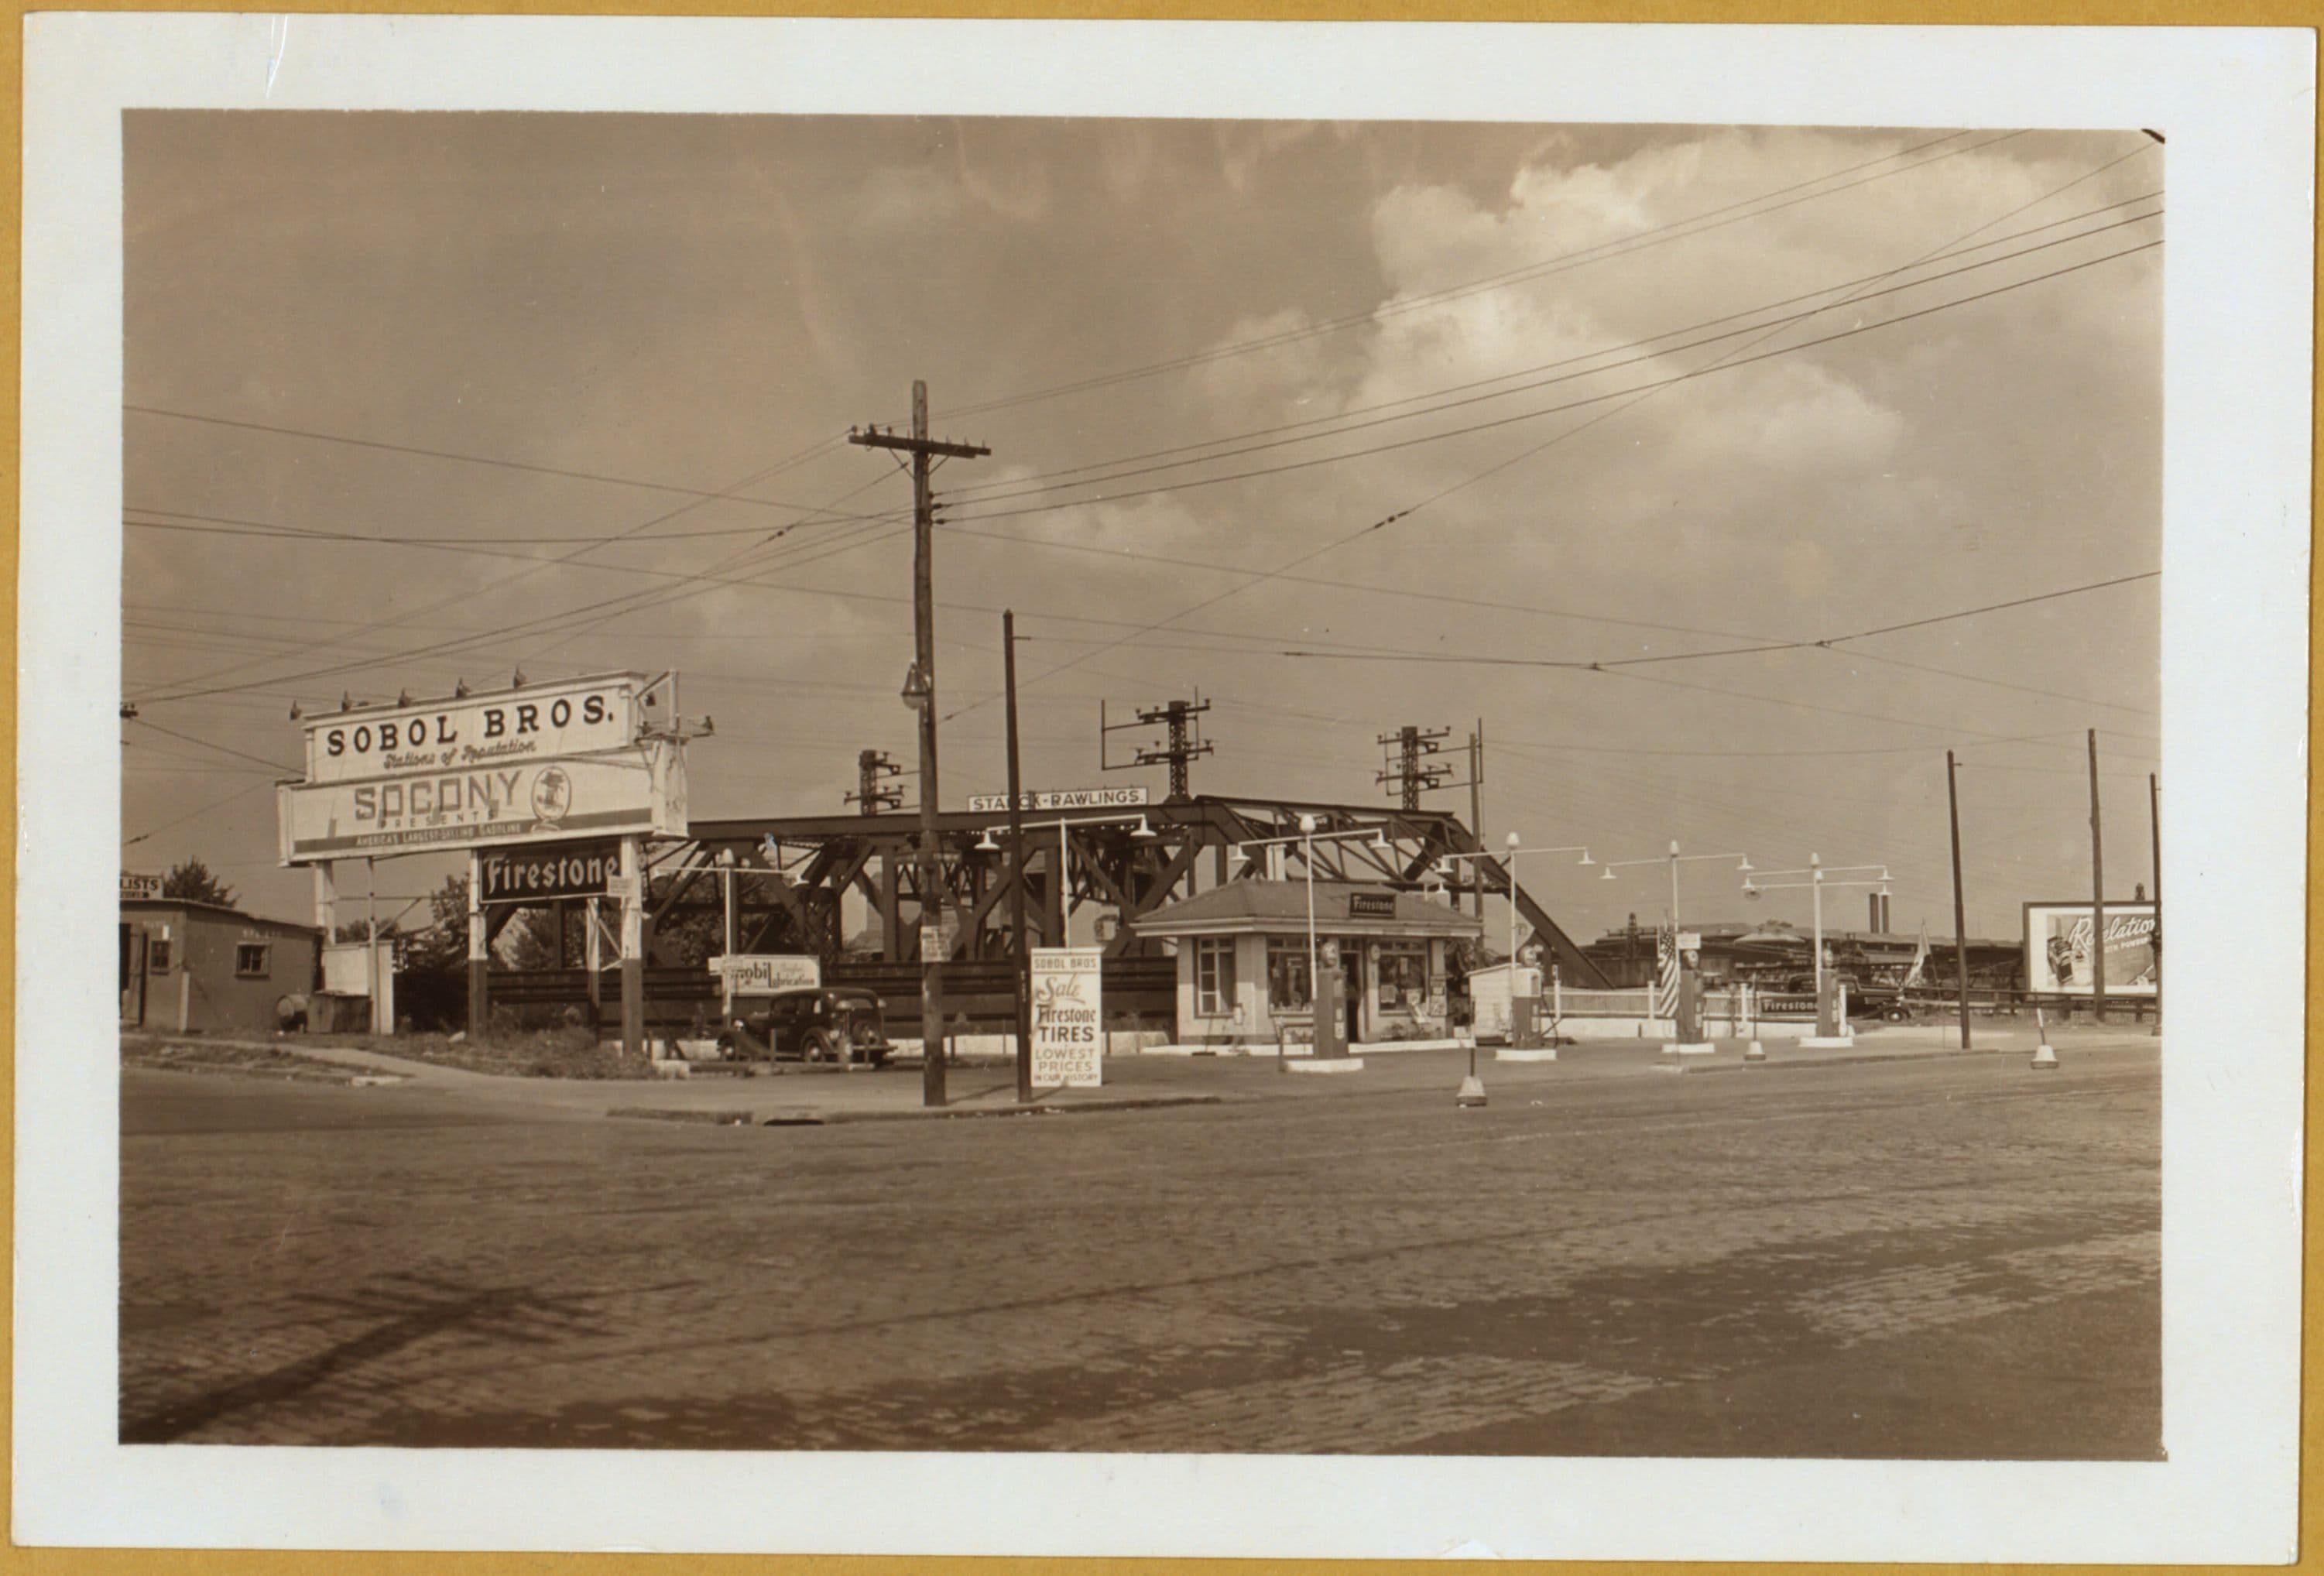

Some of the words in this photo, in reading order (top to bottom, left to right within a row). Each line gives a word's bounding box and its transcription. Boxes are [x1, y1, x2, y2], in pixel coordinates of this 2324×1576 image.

[327, 715, 458, 756] SOBOL
[484, 694, 615, 738] BROS.
[383, 752, 435, 769] Stations
[441, 747, 458, 766] of
[461, 738, 537, 762] Reputation
[355, 770, 521, 821] SOCONY
[380, 810, 495, 829] PRESENTS
[482, 853, 619, 895] Firestone
[1353, 895, 1394, 911] Firestone
[2068, 916, 2155, 953] Reelation
[1033, 958, 1065, 969] SOBOL
[1070, 958, 1097, 968] BROS
[1035, 971, 1085, 1004] Sale
[1036, 1003, 1097, 1023] Firestone
[1039, 1026, 1095, 1043] TIRES
[1034, 1047, 1095, 1060] LOWEST
[1038, 1060, 1093, 1072] PRICES
